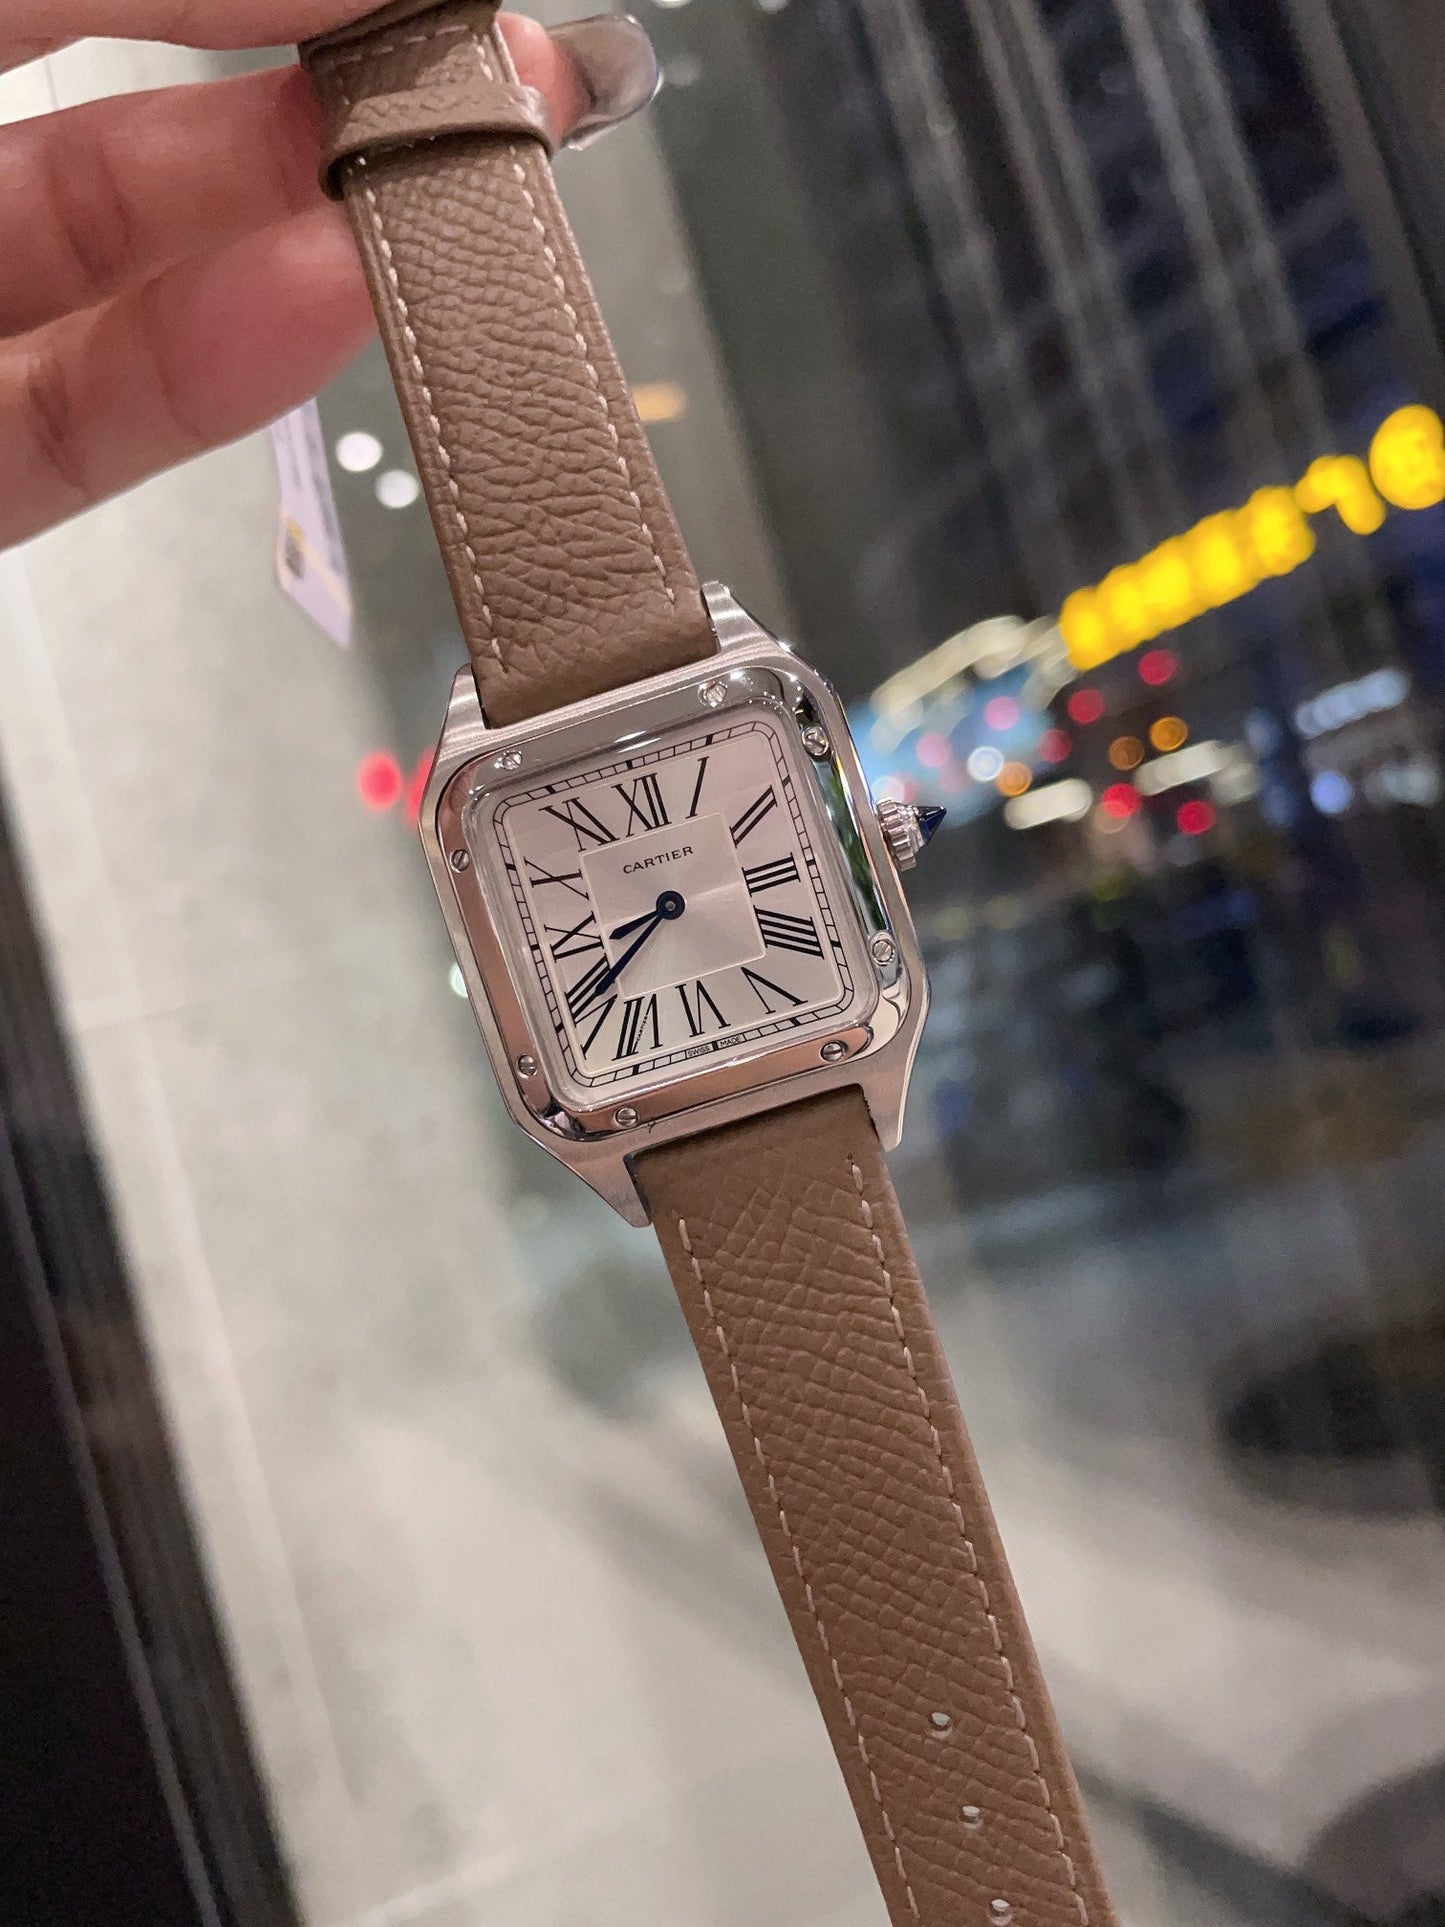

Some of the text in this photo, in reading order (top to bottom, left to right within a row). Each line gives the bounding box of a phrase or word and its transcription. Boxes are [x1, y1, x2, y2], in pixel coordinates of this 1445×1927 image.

[539, 797, 619, 852] XI
[611, 773, 672, 836] XII
[730, 785, 778, 849] II
[524, 857, 589, 900] X
[623, 846, 694, 873] CARTIER
[742, 852, 800, 897] III
[544, 911, 603, 963] IX
[754, 906, 825, 959] IIII
[676, 980, 731, 1038] VI
[741, 966, 808, 1014] V
[612, 993, 662, 1060] VII
[687, 1035, 742, 1057] SWISS MADE
